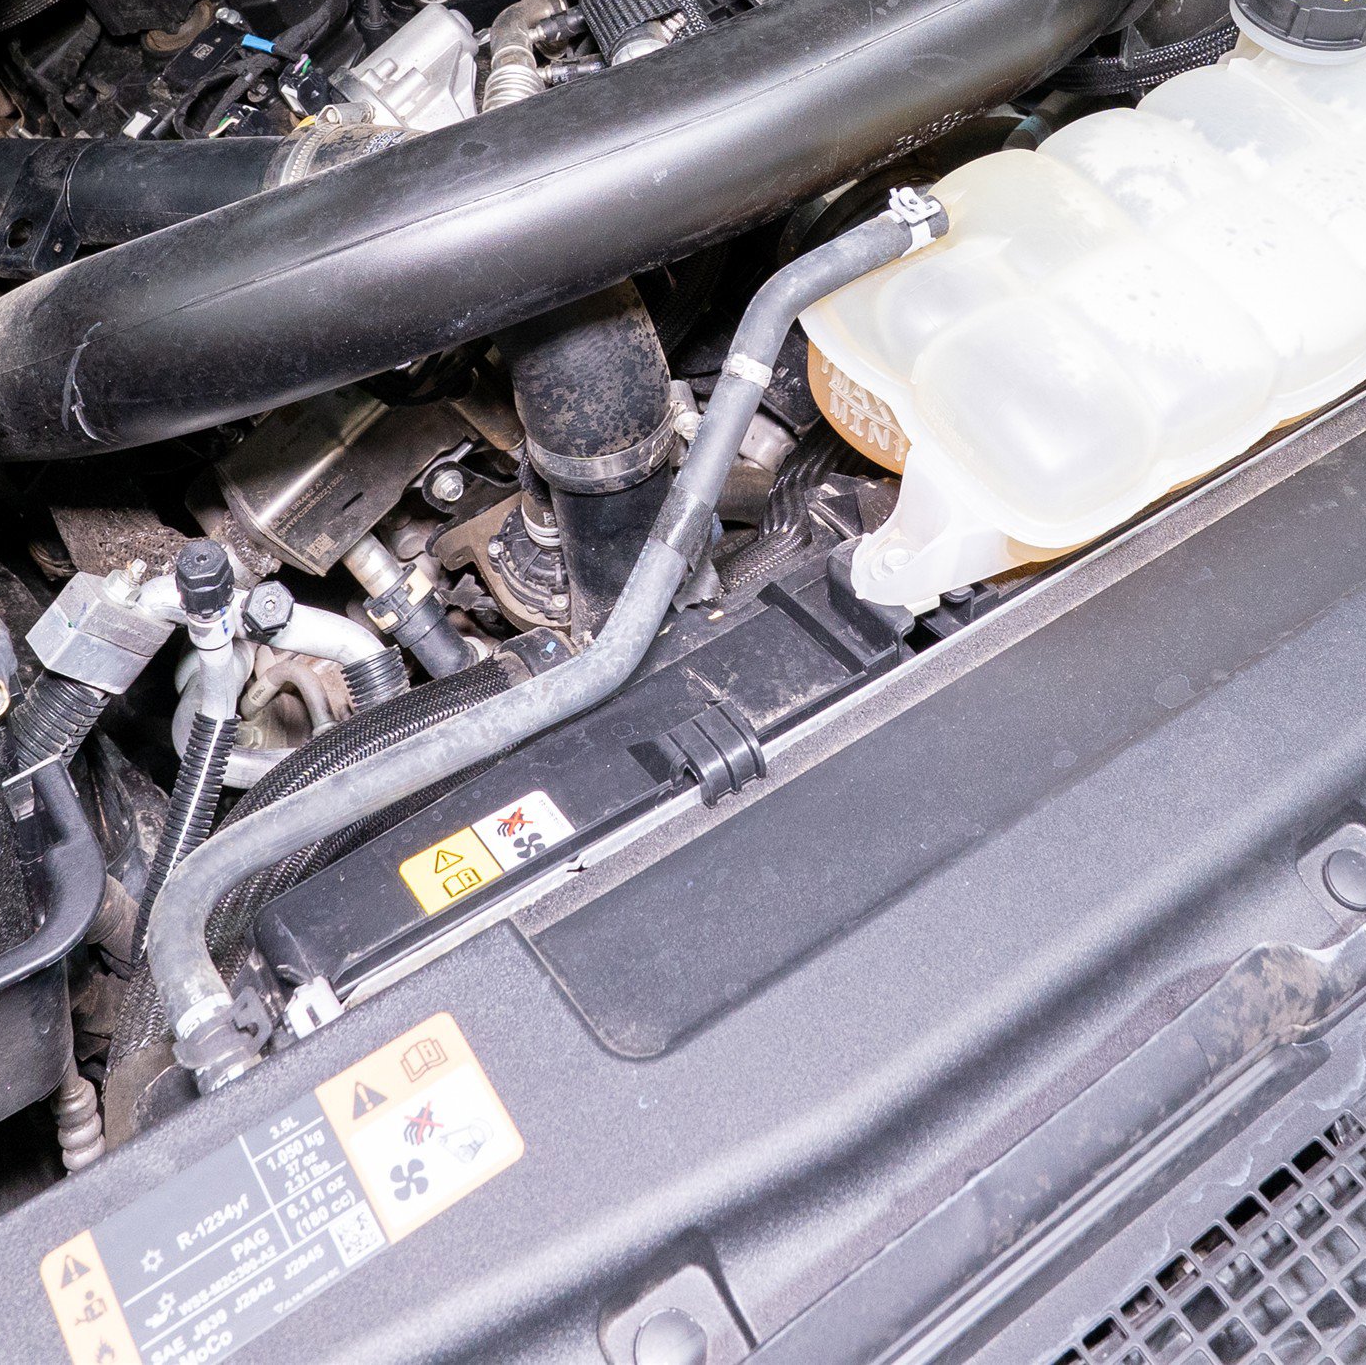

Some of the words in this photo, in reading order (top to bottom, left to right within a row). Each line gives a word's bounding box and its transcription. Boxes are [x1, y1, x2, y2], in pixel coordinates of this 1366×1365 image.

[829, 392, 890, 451] MIN
[269, 1116, 300, 1140] 3.5L
[266, 1139, 304, 1171] 1.050
[303, 1129, 325, 1149] kg
[285, 1159, 300, 1177] 37
[301, 1151, 319, 1166] oz
[284, 1172, 311, 1195] 2.31
[309, 1160, 331, 1178] lbs
[286, 1195, 311, 1220] 6.1
[310, 1185, 325, 1204] fl
[326, 1175, 347, 1194] oz
[295, 1205, 329, 1238] (180
[330, 1189, 356, 1213] cc)
[176, 1193, 250, 1251] R-1234yf
[230, 1227, 270, 1262] PAG
[151, 1335, 187, 1365] SAE
